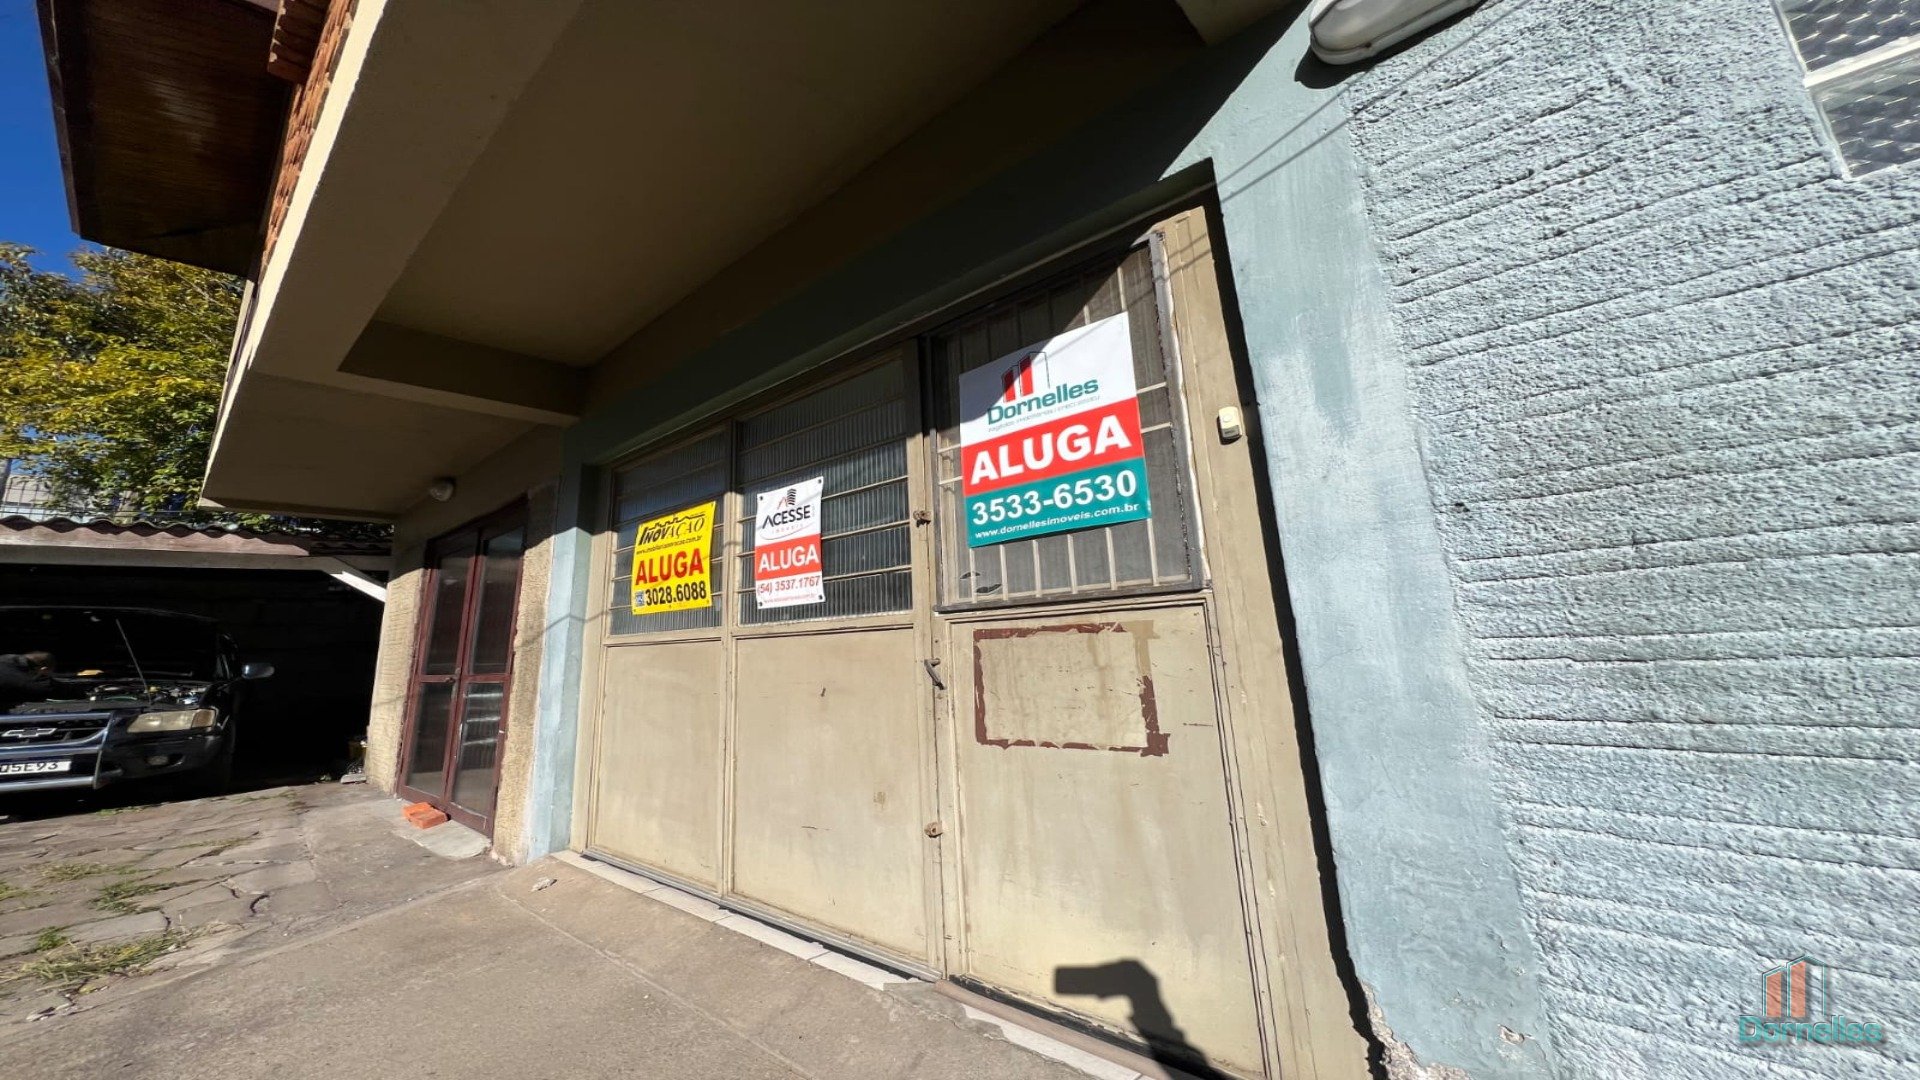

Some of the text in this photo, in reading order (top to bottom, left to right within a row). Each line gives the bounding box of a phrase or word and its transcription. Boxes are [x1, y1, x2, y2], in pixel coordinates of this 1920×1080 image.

[988, 378, 1099, 425] Dornelles
[970, 414, 1132, 485] ALUGA
[972, 470, 1137, 525] 3533-6530
[762, 504, 811, 529] ACESSE
[975, 503, 1139, 539] www.dornellesimoveis.com.br
[635, 547, 704, 586] ALUGA
[758, 543, 819, 573] ALUGA
[645, 580, 707, 606] 3028.6088
[757, 575, 821, 596] (54) 3537.1767
